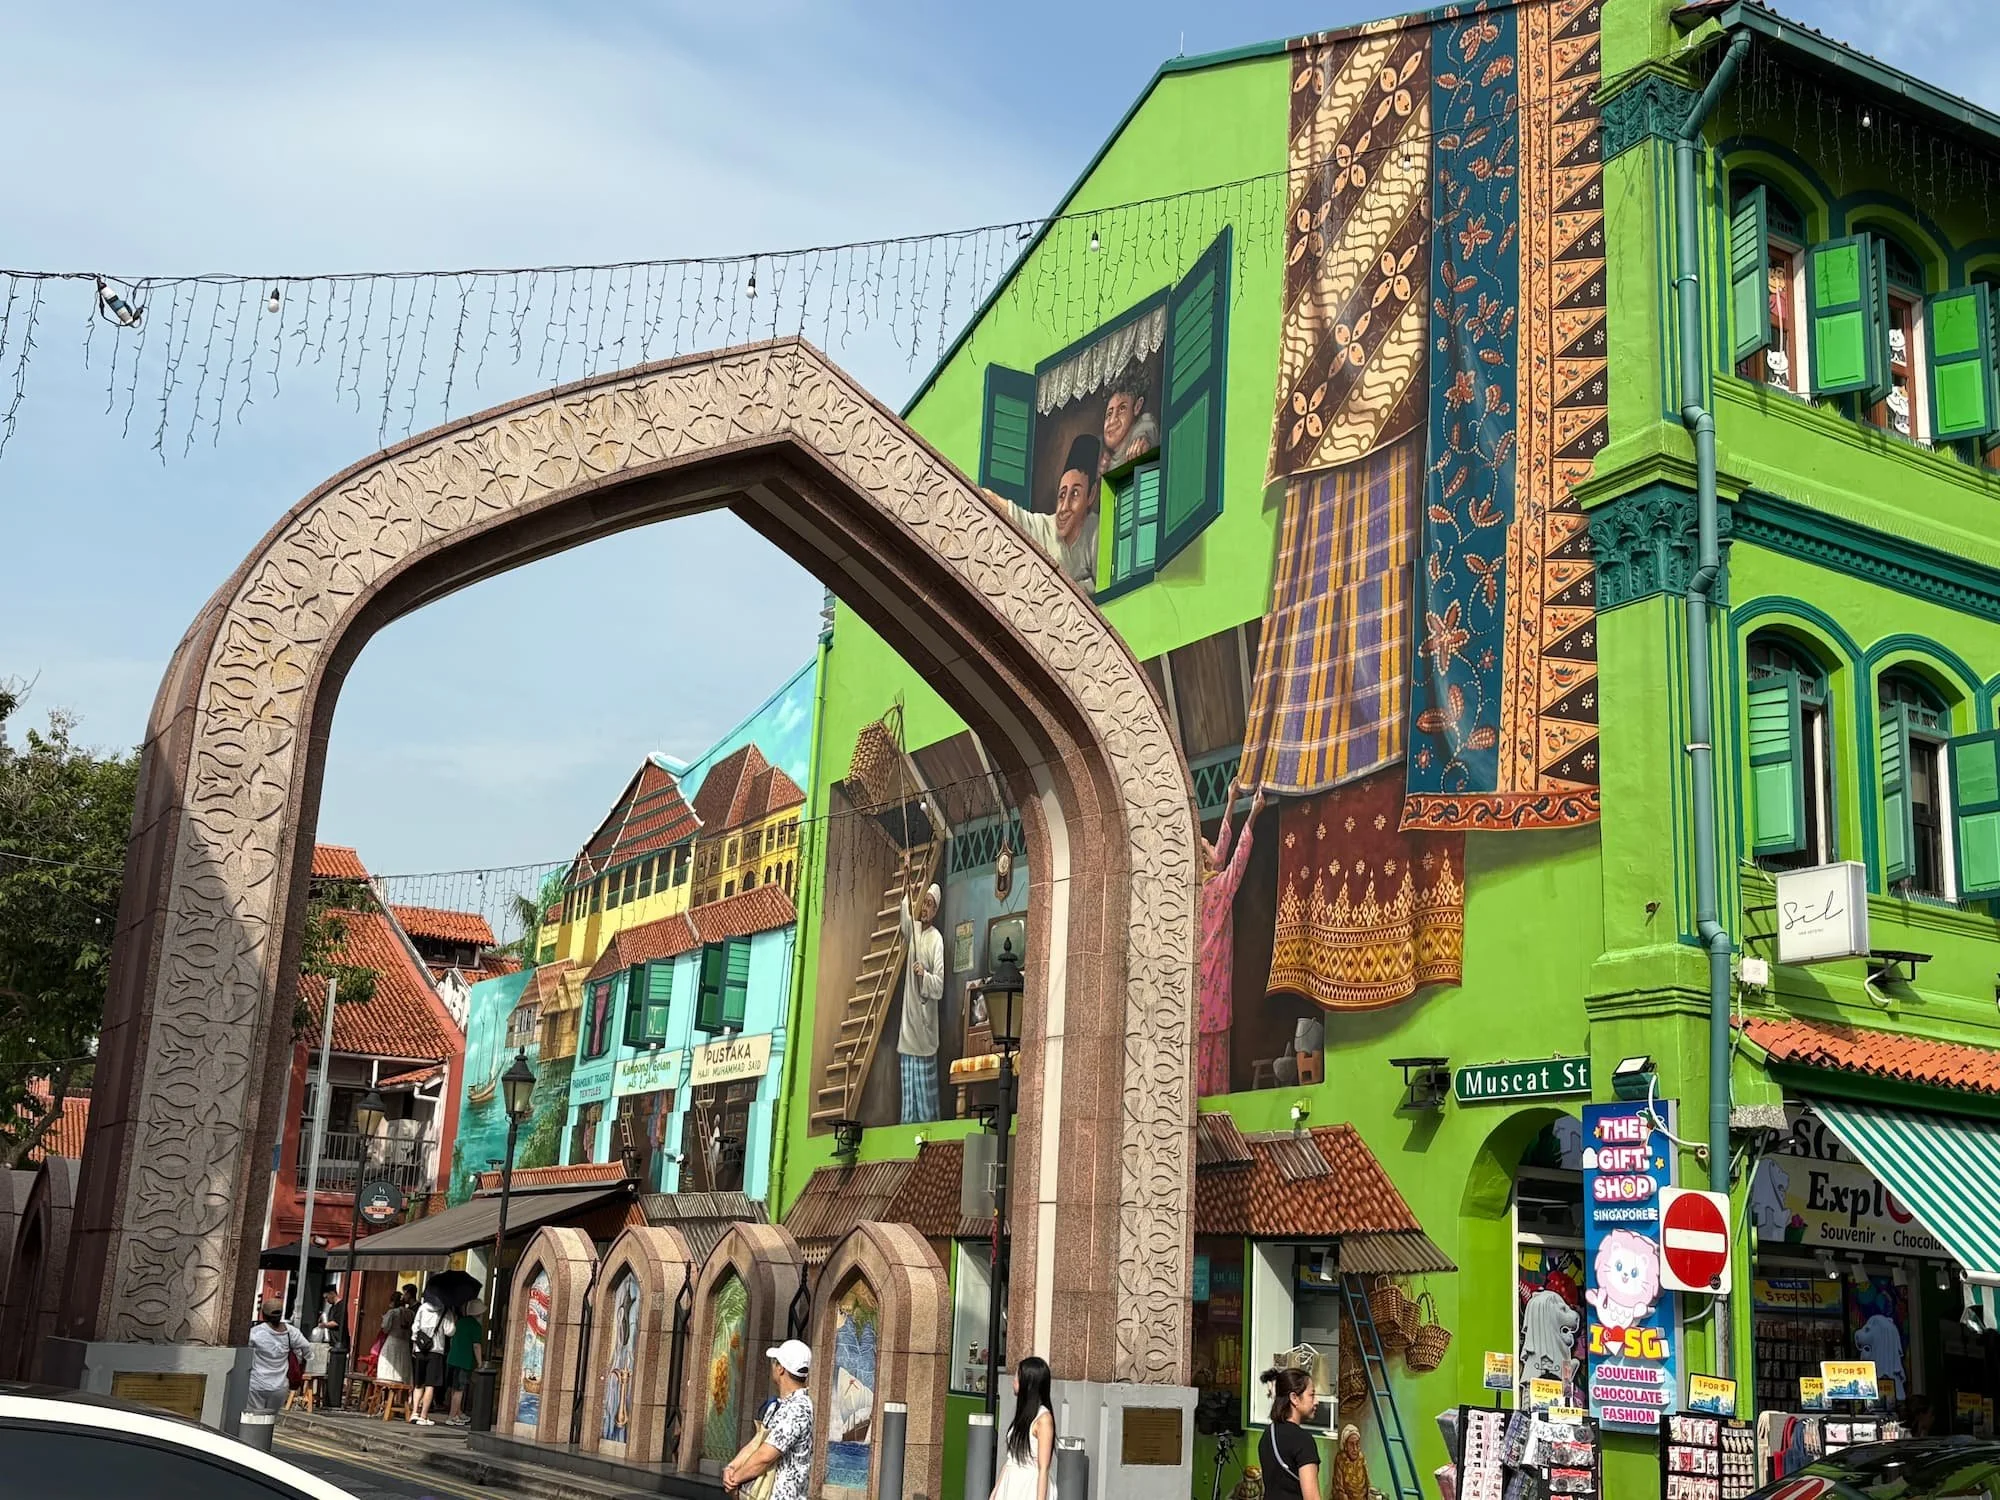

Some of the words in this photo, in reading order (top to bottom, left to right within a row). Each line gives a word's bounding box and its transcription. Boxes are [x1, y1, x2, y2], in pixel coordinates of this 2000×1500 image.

[705, 1042, 751, 1065] PUSTAKA
[712, 1062, 746, 1077] MUHAMMAD
[1465, 1066, 1550, 1096] Muscat
[1562, 1062, 1588, 1089] St
[1600, 1118, 1640, 1141] THE
[1599, 1146, 1646, 1170] GIFT
[1594, 1177, 1651, 1200] SHOP
[1593, 1208, 1650, 1221] SINGAPORE
[1820, 1222, 1876, 1244] Souvenir
[1893, 1229, 1948, 1251] Chocola
[1590, 1325, 1604, 1353] I
[1624, 1328, 1663, 1358] SG
[1597, 1366, 1658, 1383] SOUVENIR
[1837, 1367, 1855, 1376] FOR
[1541, 1387, 1554, 1395] FOR
[1593, 1386, 1663, 1404] CHOCOLATE
[1703, 1381, 1719, 1391] FOR
[1720, 1383, 1729, 1392] $1
[1603, 1407, 1656, 1423] FASHION
